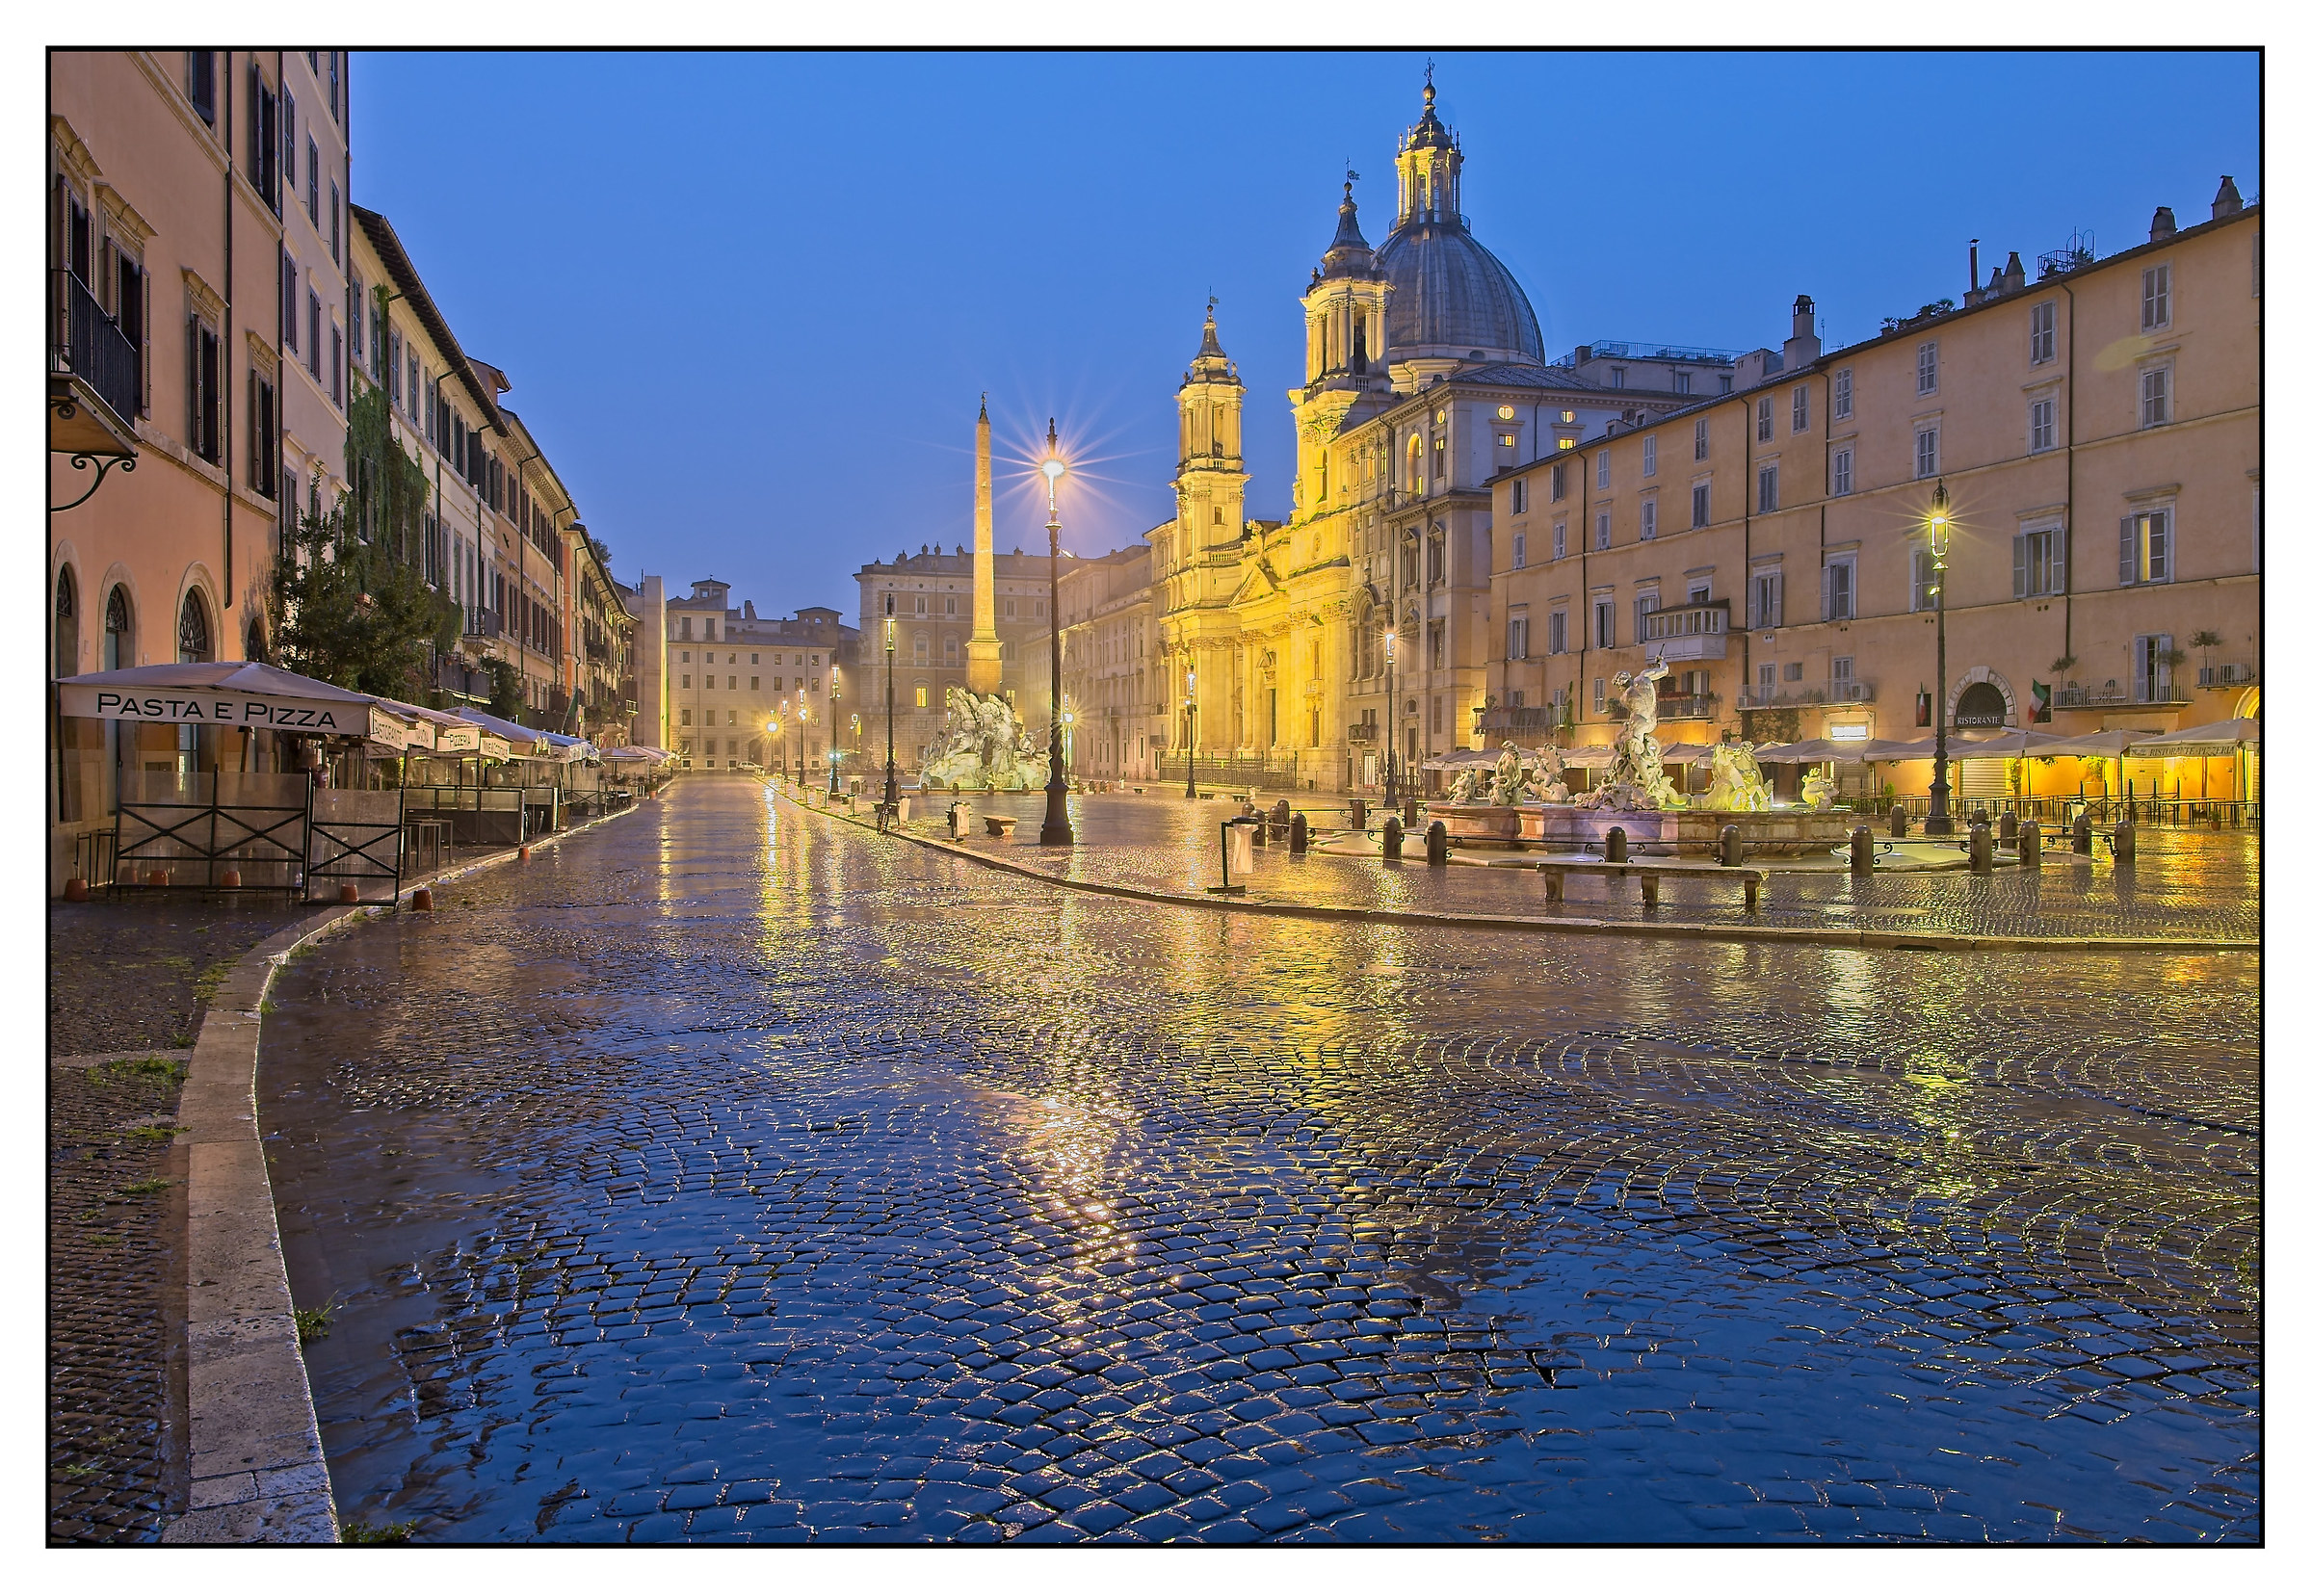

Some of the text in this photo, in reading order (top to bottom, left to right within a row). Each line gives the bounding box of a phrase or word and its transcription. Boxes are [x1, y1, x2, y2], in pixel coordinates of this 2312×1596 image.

[97, 693, 337, 729] PASTA E PIZZA
[1957, 716, 2001, 725] RISTORANTE
